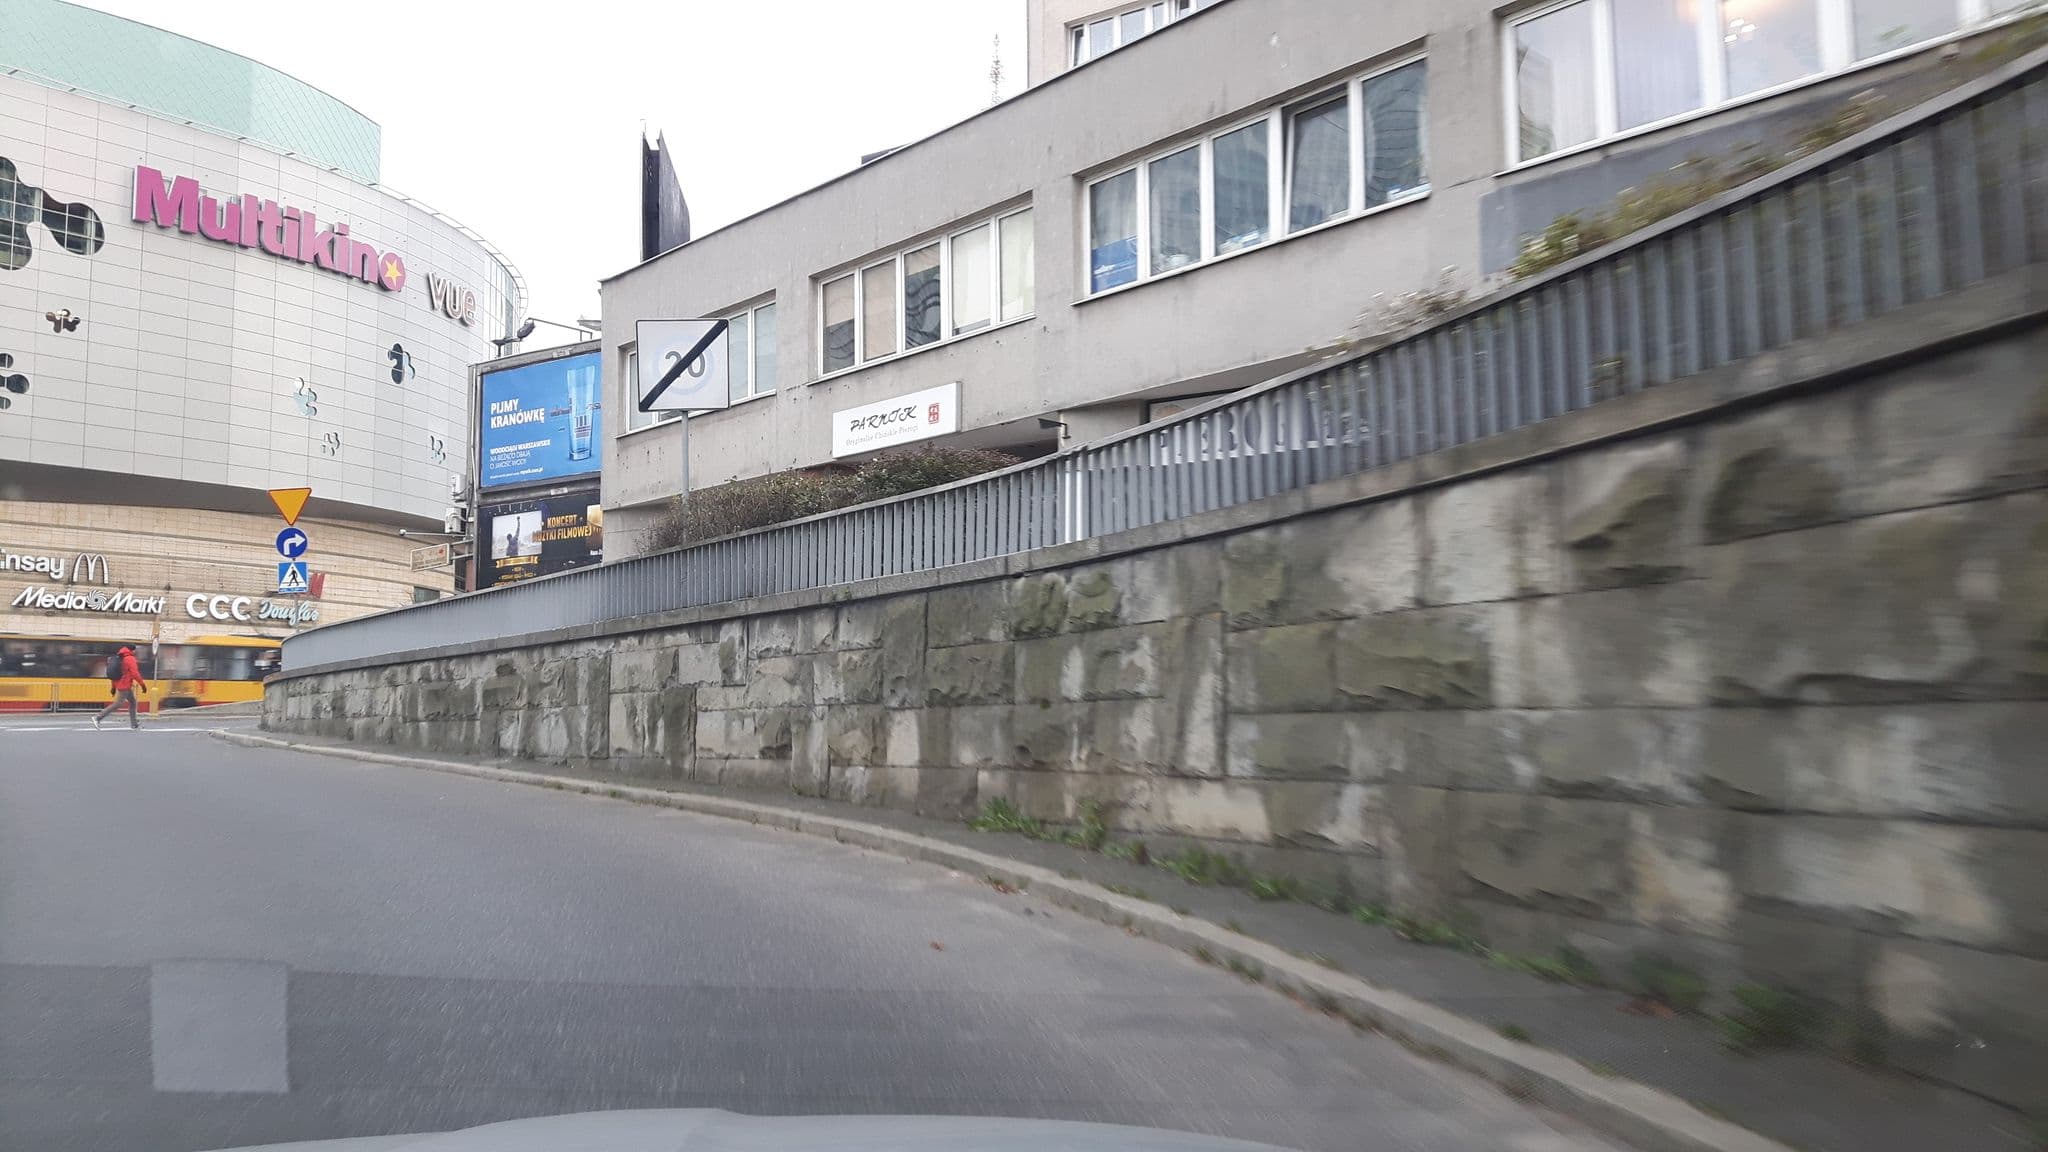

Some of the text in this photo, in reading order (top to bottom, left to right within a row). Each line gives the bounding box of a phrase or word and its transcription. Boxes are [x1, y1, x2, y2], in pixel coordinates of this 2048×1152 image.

[132, 165, 407, 292] Multikino
[665, 350, 706, 378] 20
[491, 399, 519, 415] PIJMY
[491, 408, 545, 429] KRANÓWKĘ
[547, 514, 577, 528] KONCERT
[557, 525, 592, 540] FILMOWEJ
[186, 593, 251, 621] CCC
[259, 599, 319, 625] Douglas
